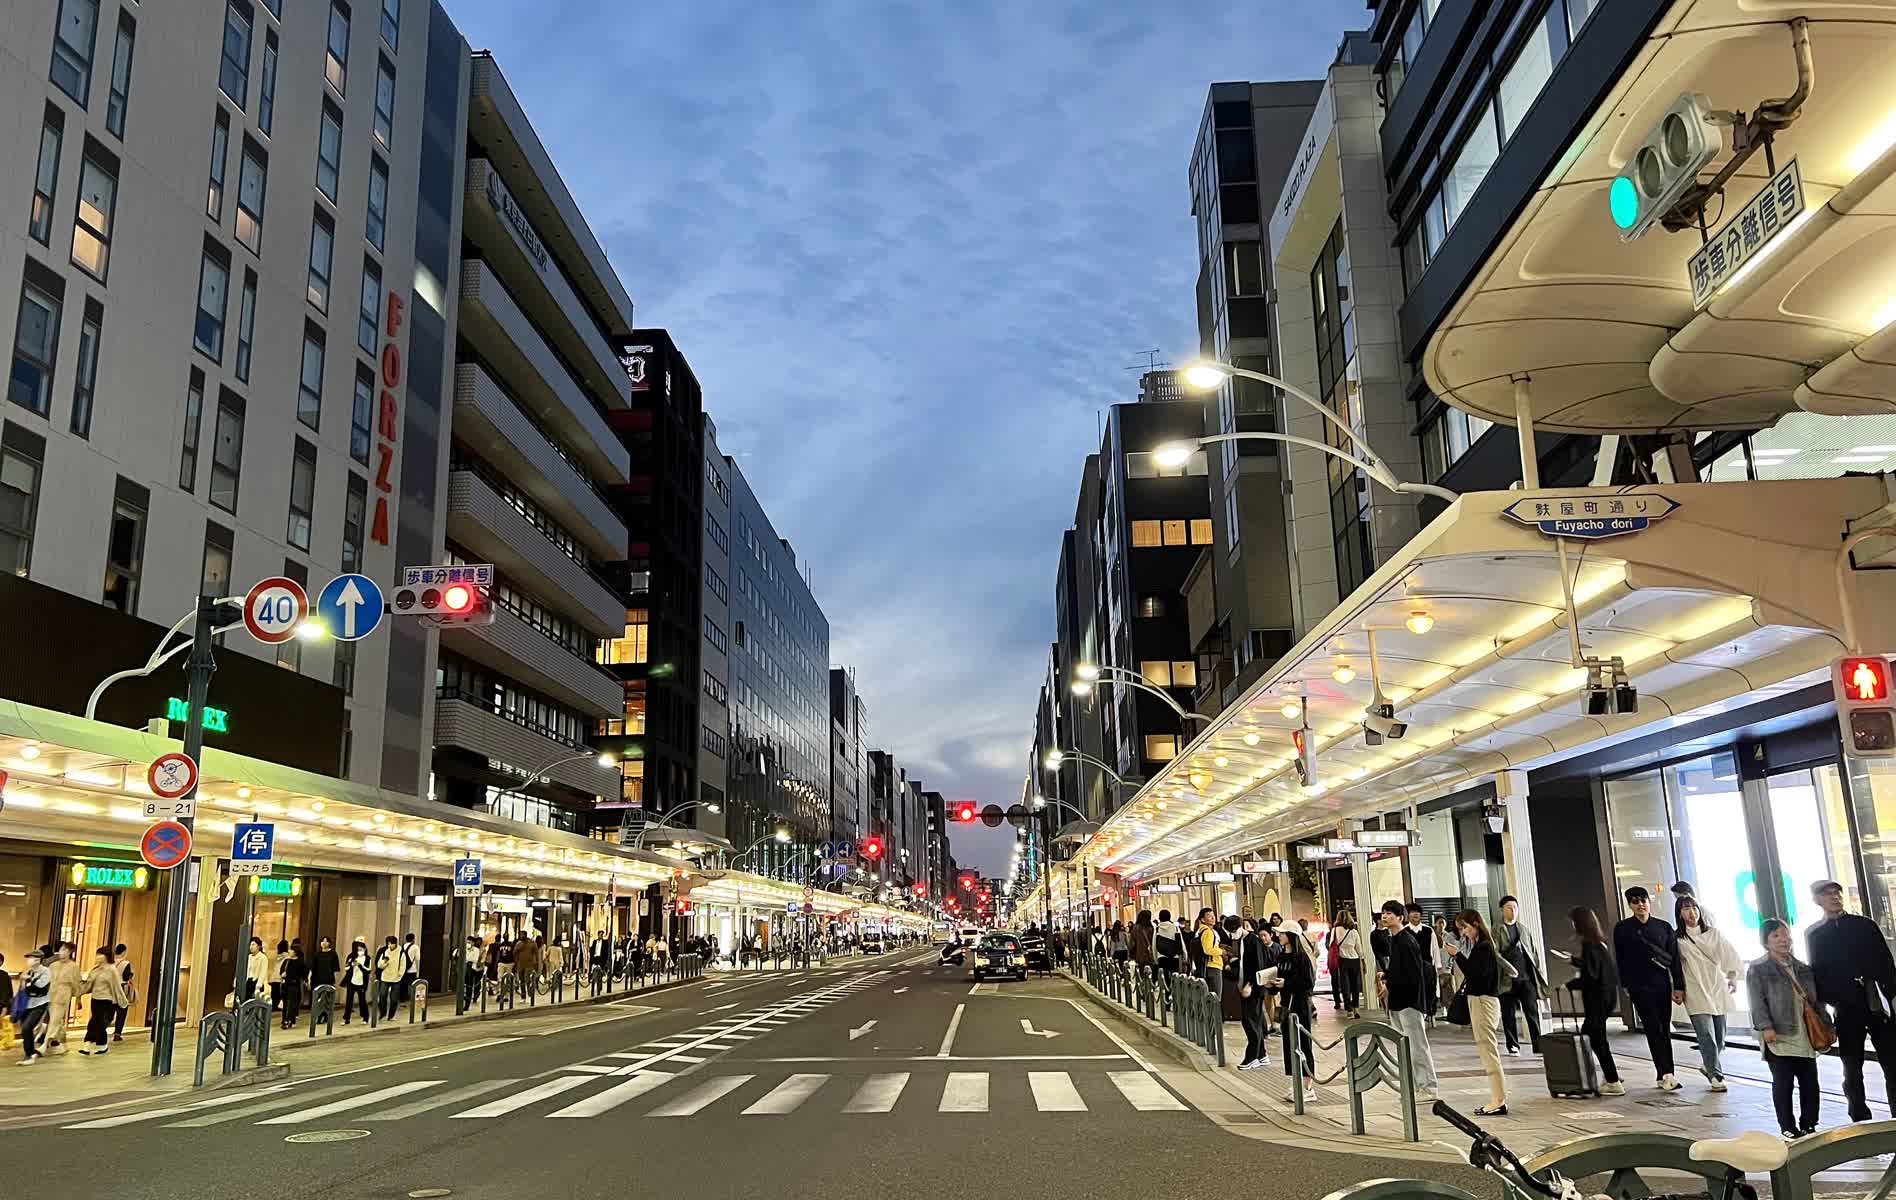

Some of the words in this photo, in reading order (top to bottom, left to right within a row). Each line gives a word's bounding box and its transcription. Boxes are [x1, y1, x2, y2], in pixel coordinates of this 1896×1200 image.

[1694, 173, 1796, 298] 歩車分離信号
[370, 288, 403, 546] FORZA
[1555, 520, 1604, 532] Fuyacho
[1611, 518, 1633, 529] dori
[407, 567, 489, 585] 歩車分離信号
[258, 595, 294, 624] 40
[167, 697, 227, 732] REX
[239, 828, 268, 855] 停
[86, 867, 133, 885] ROLEX
[232, 864, 270, 872] ここから
[458, 863, 478, 882] 停
